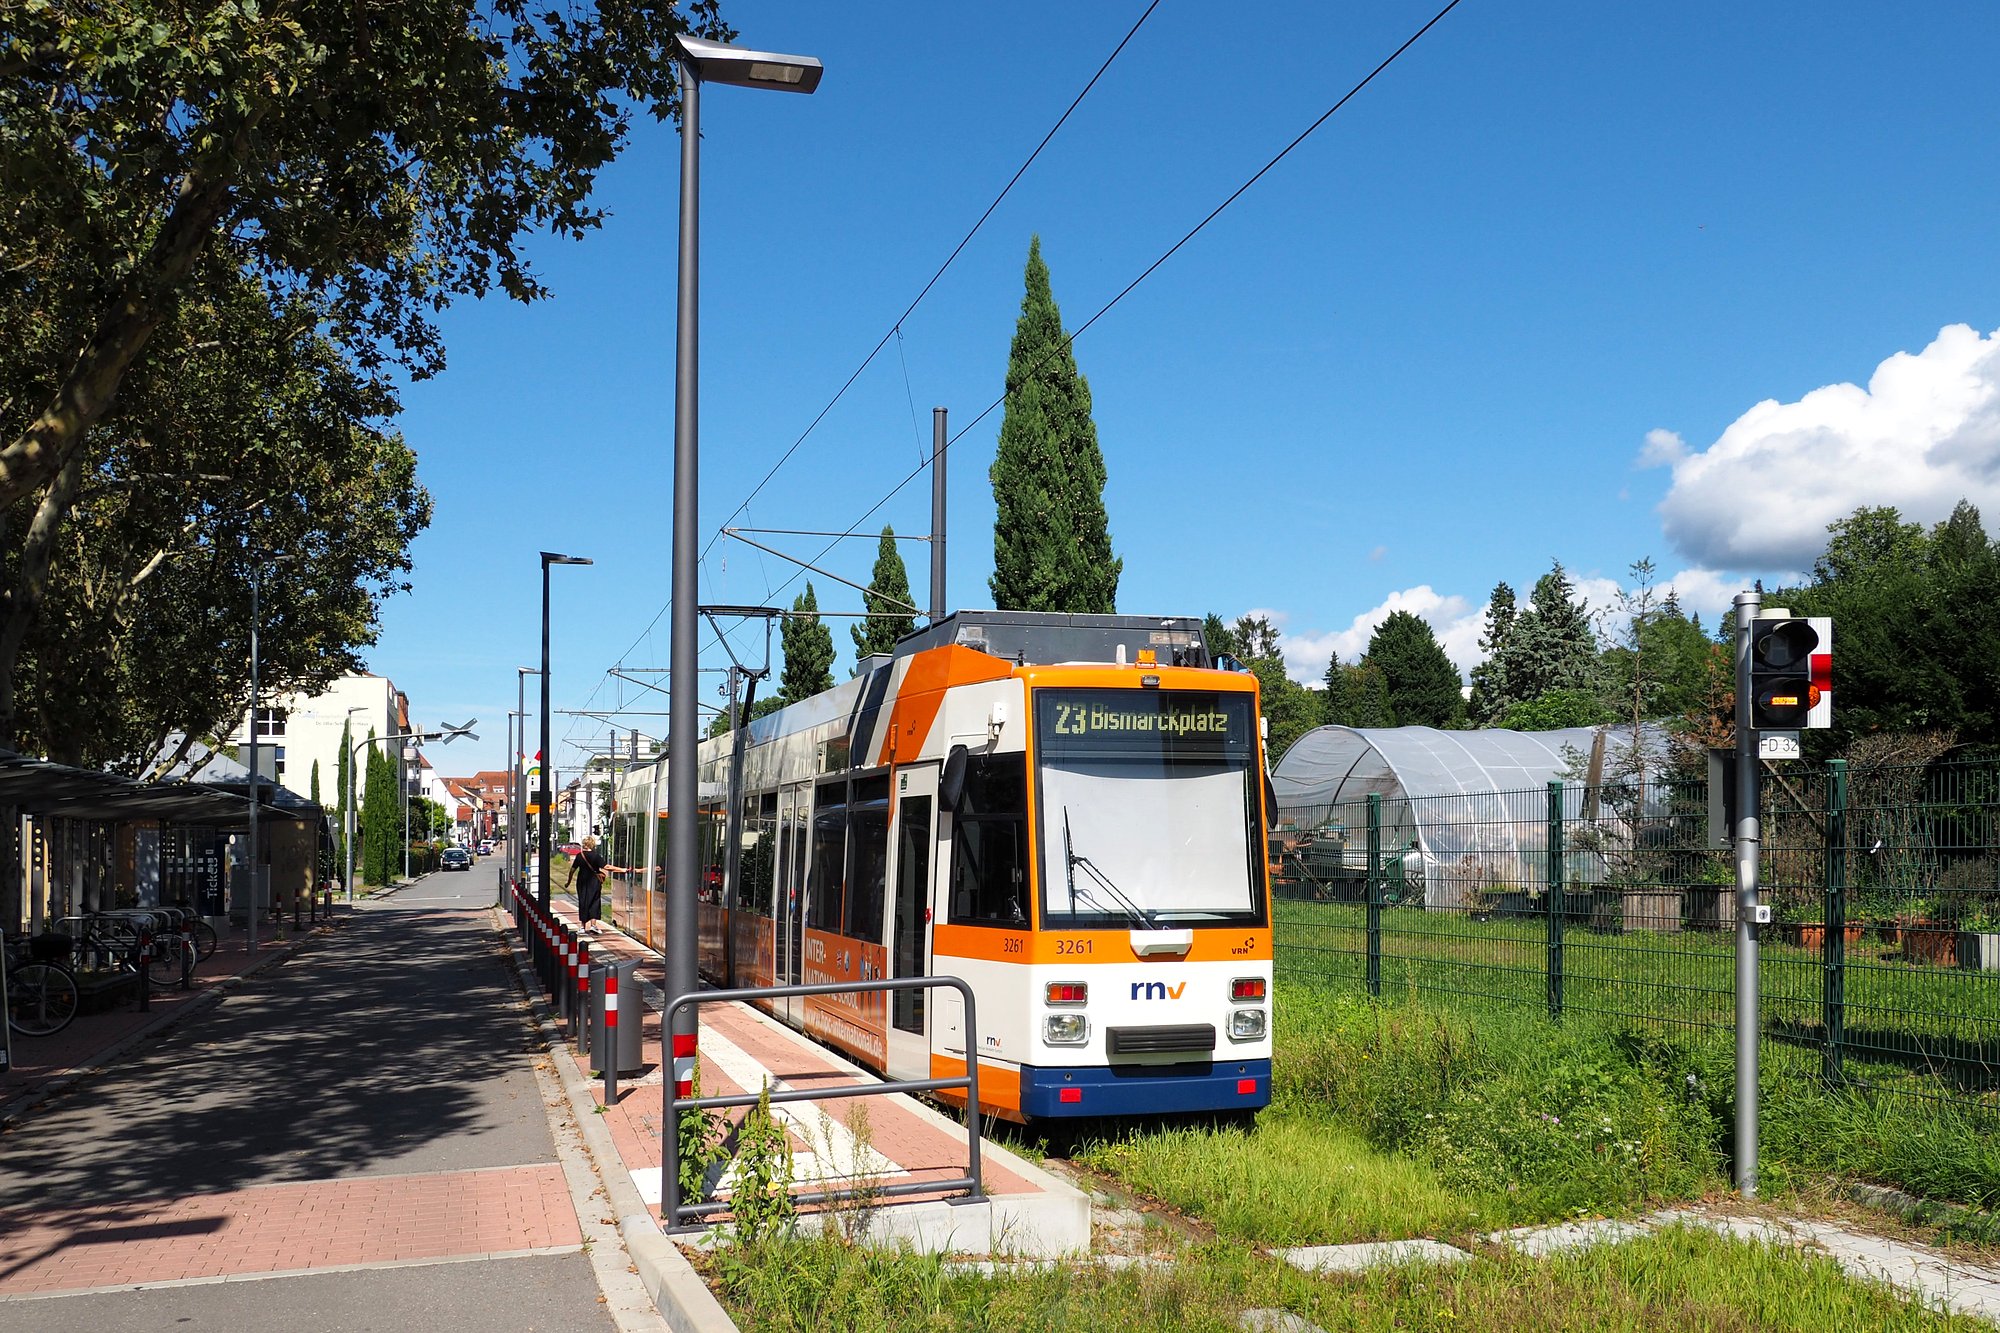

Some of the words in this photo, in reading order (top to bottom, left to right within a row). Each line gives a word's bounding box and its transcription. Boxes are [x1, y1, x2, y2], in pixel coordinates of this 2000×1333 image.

[1055, 701, 1086, 734] 23
[1091, 703, 1228, 736] Bismarckplatz
[1760, 738, 1778, 752] FD
[1782, 738, 1798, 752] 32
[1003, 938, 1024, 953] 3261
[1056, 939, 1093, 954] 3261
[1231, 947, 1249, 955] VRN
[1131, 981, 1187, 1001] rnv
